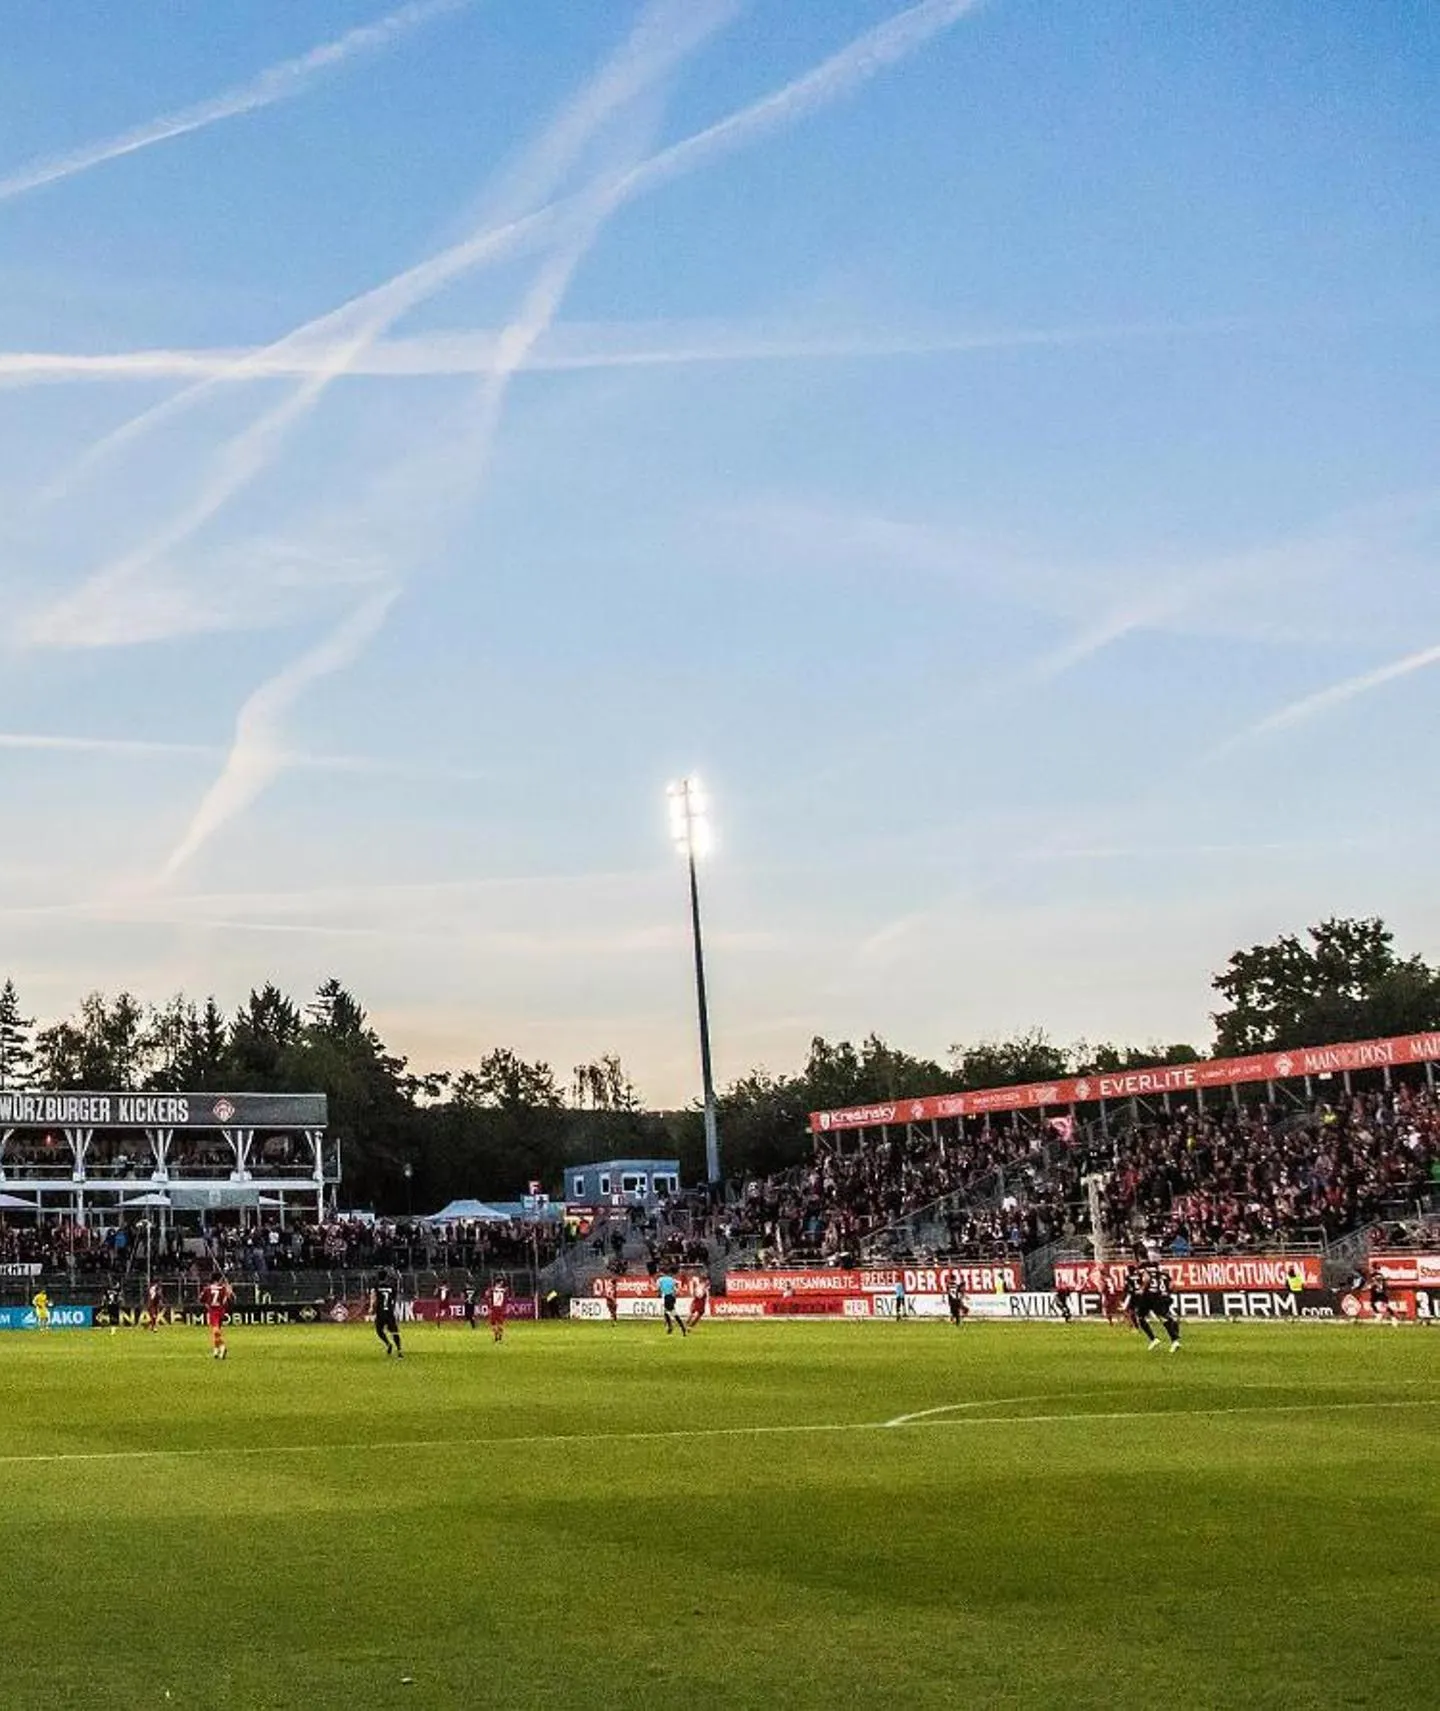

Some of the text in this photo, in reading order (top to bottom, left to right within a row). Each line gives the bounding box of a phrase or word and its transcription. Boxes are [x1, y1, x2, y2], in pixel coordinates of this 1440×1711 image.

[1360, 1042, 1394, 1064] POST
[1410, 1036, 1440, 1058] MAI
[1100, 1069, 1197, 1096] EVERLITE
[0, 1093, 111, 1122] WÜRZBURGER
[118, 1097, 190, 1122] KICKERS
[904, 1270, 938, 1292] DER
[940, 1267, 1016, 1292] CTERER
[48, 1311, 83, 1325] AKO
